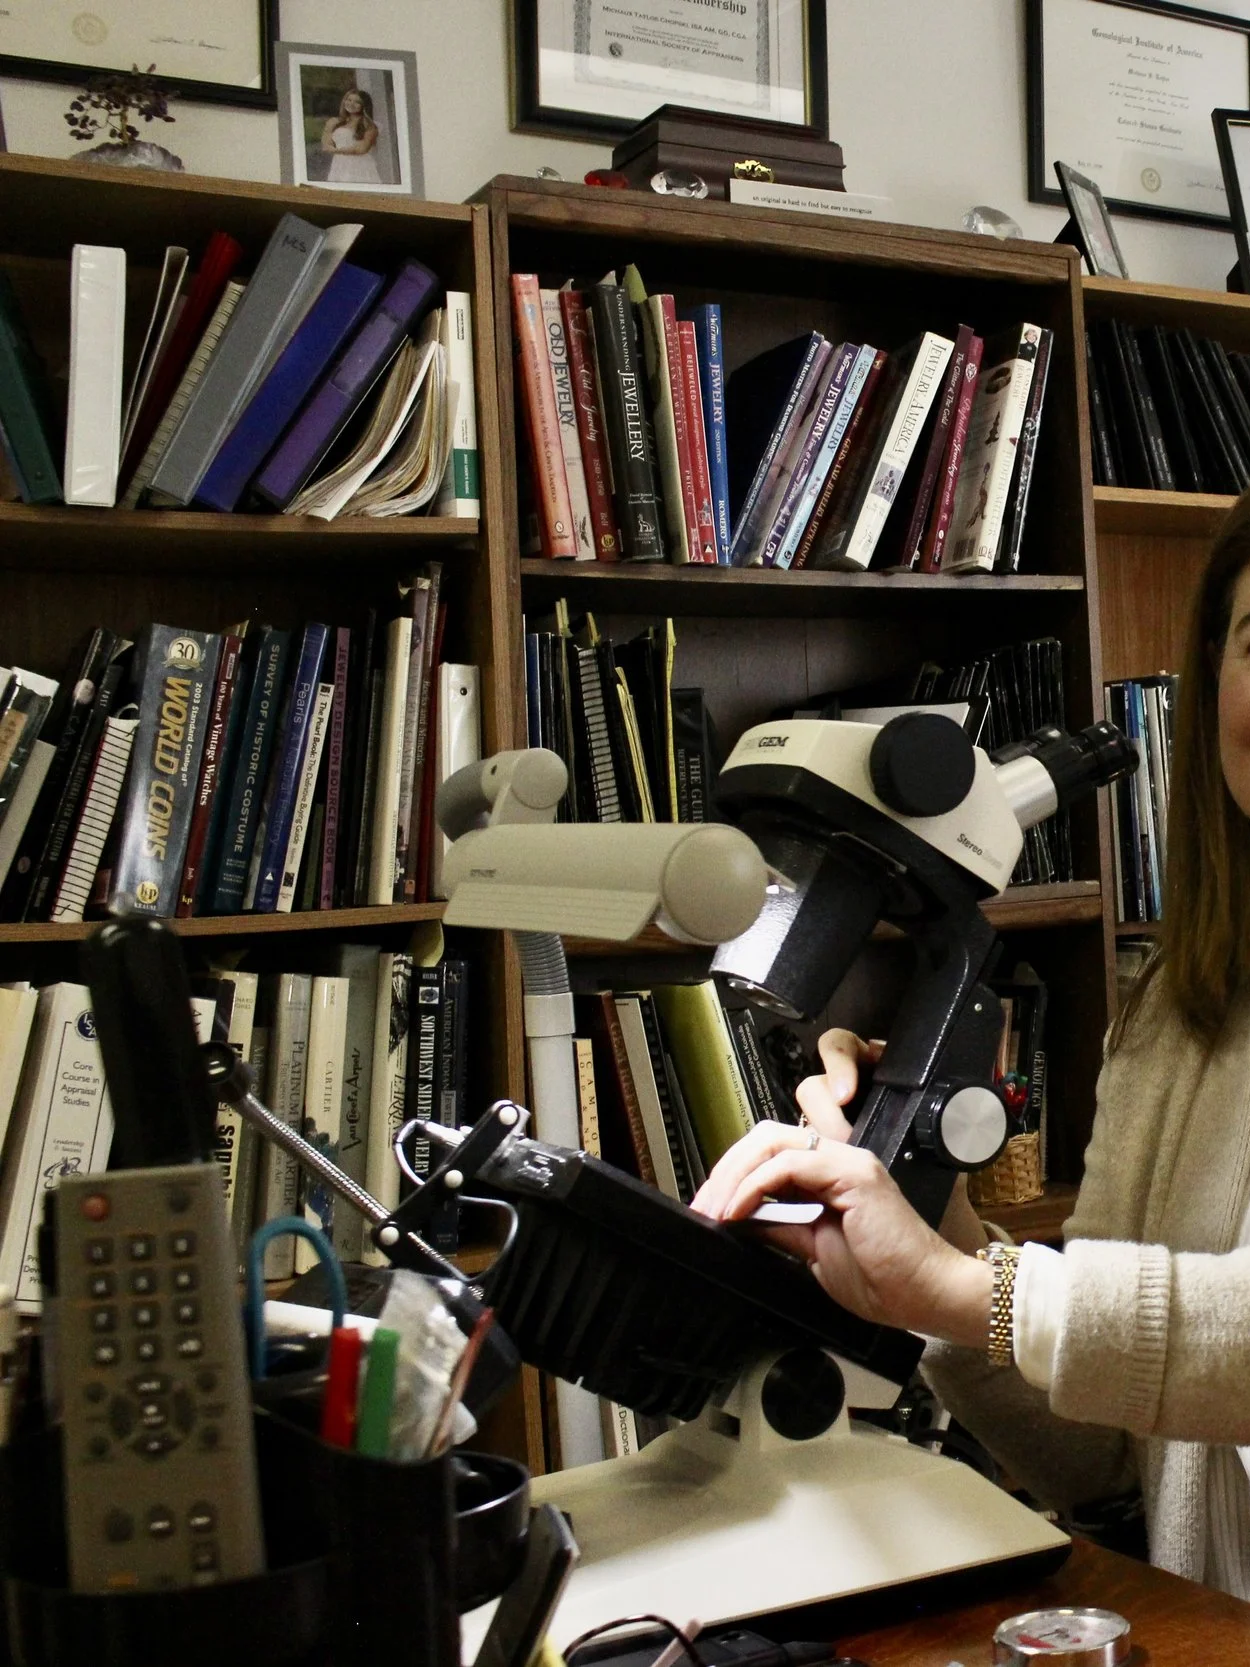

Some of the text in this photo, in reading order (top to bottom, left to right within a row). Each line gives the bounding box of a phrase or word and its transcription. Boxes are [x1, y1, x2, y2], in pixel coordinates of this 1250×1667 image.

[547, 321, 566, 358] OLD
[955, 351, 964, 364] The
[549, 357, 578, 429] JEWELRY
[614, 292, 646, 462] UNDERSTANDING JEWELLERY
[709, 361, 722, 424] JEWELRY
[893, 339, 948, 456] JEWELRY AMERICA
[948, 364, 961, 387] Glitter
[577, 389, 600, 442] Jewelry
[766, 341, 818, 460] PHOTO MASTERS FOR DIAMOND GRADING
[809, 383, 841, 440] JEWELRY
[940, 407, 950, 424] Gold
[944, 394, 953, 407] The
[824, 397, 853, 453] JEWELRY
[946, 440, 961, 477] Jewelry
[717, 499, 726, 538] ROMERO
[177, 643, 195, 658] 30
[262, 643, 280, 696] SURVEY
[192, 681, 202, 703] 2003
[258, 699, 269, 717] OF
[292, 681, 310, 725] Pearls
[187, 704, 199, 741] Standard
[206, 721, 224, 761] Vintage
[138, 675, 194, 862] WORLD COINS
[180, 742, 192, 772] Catalog
[245, 721, 266, 784] HISTORIC
[292, 700, 327, 844] The Pearl Book: The Definitive Buying Guide
[324, 646, 348, 865] JEWELRY DESIGN SOURCE BOOK
[688, 754, 701, 783] THE
[198, 762, 216, 807] Watches
[232, 788, 252, 853] COSTUME
[957, 833, 983, 856] Stereo
[441, 996, 455, 1051] AMERICAN
[743, 1022, 759, 1061] Gemstones
[62, 1072, 91, 1083] Course
[73, 1061, 93, 1071] Core
[322, 1060, 335, 1113] CARTIER
[344, 1047, 362, 1089] Arpels
[415, 1013, 436, 1119] SOUTHWEST SILVER
[723, 1053, 749, 1118] American Jewelry
[756, 1067, 772, 1101] Inclusions
[1029, 1049, 1045, 1109] GEMOLOGY
[61, 1085, 96, 1096] Appraisal
[63, 1096, 90, 1107] Studies
[584, 1060, 599, 1156] CAMEOS
[282, 1150, 299, 1205] ARTIER
[618, 1410, 630, 1455] Dictionar
